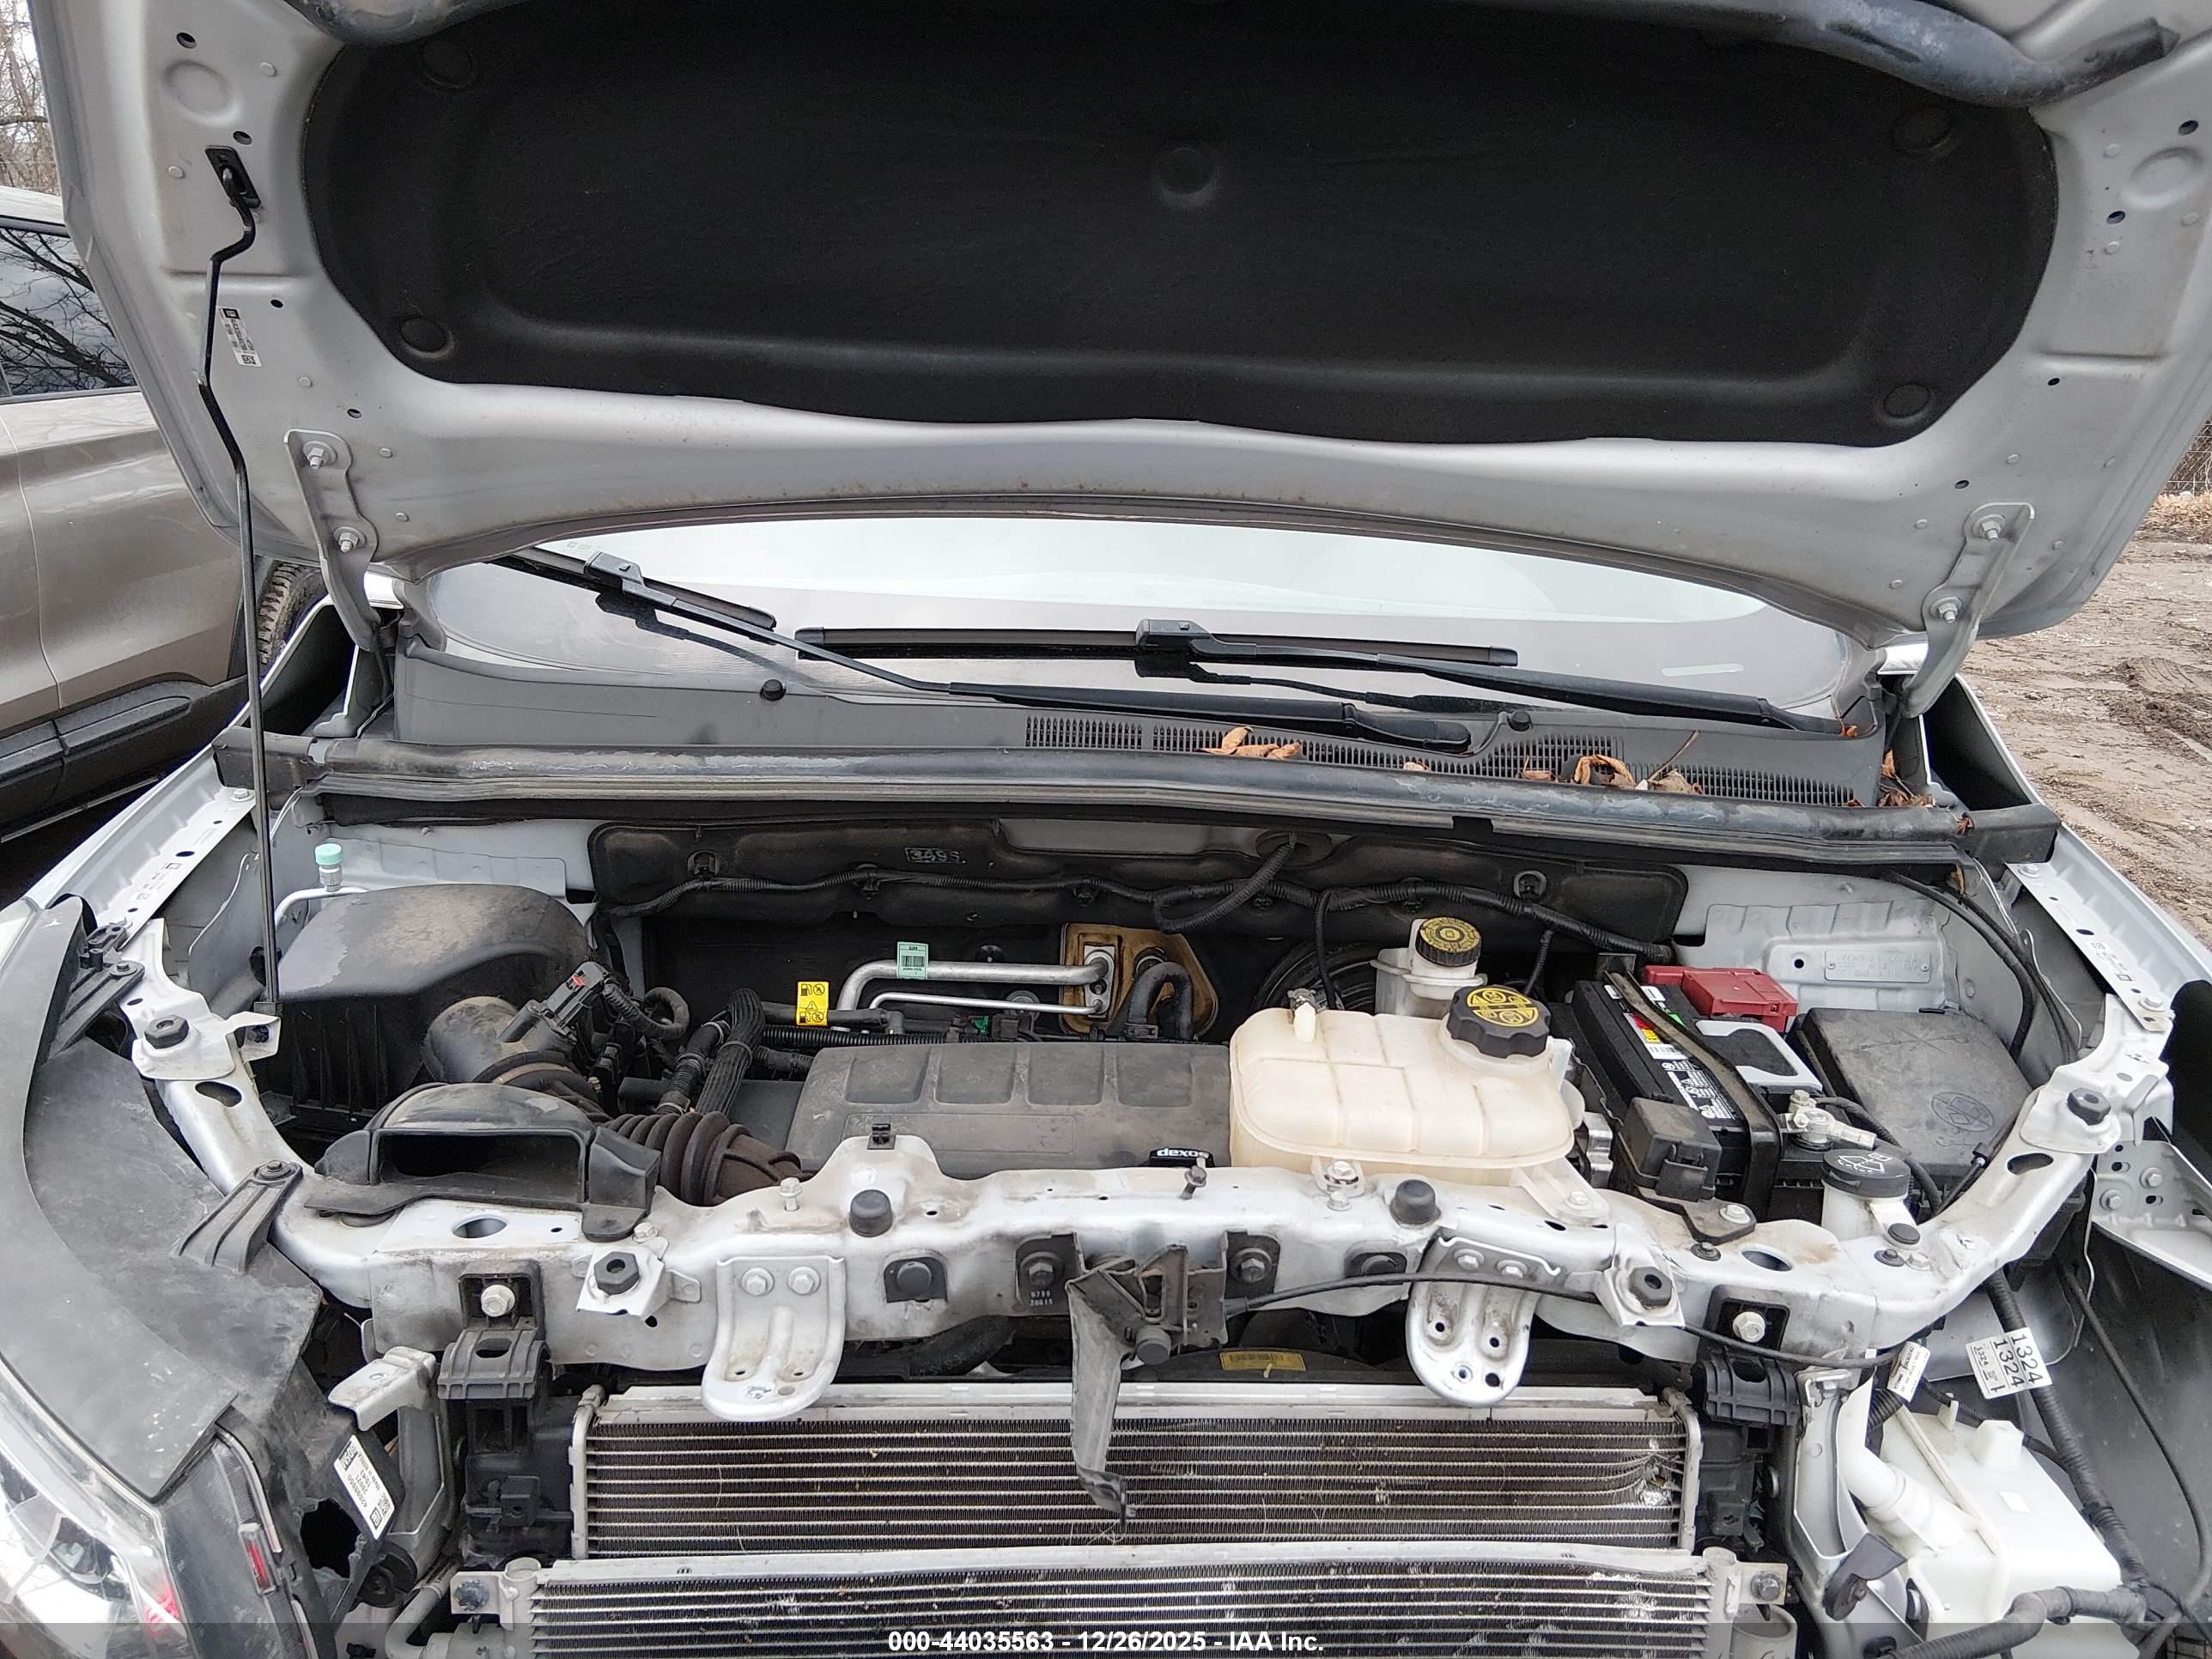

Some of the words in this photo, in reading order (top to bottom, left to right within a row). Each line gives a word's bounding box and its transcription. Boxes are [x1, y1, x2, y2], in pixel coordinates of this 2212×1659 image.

[1156, 1147, 1210, 1158] dexos
[1976, 1346, 1990, 1366] 1324
[1993, 1339, 2025, 1387] 1324
[2011, 1334, 2044, 1383] 1324
